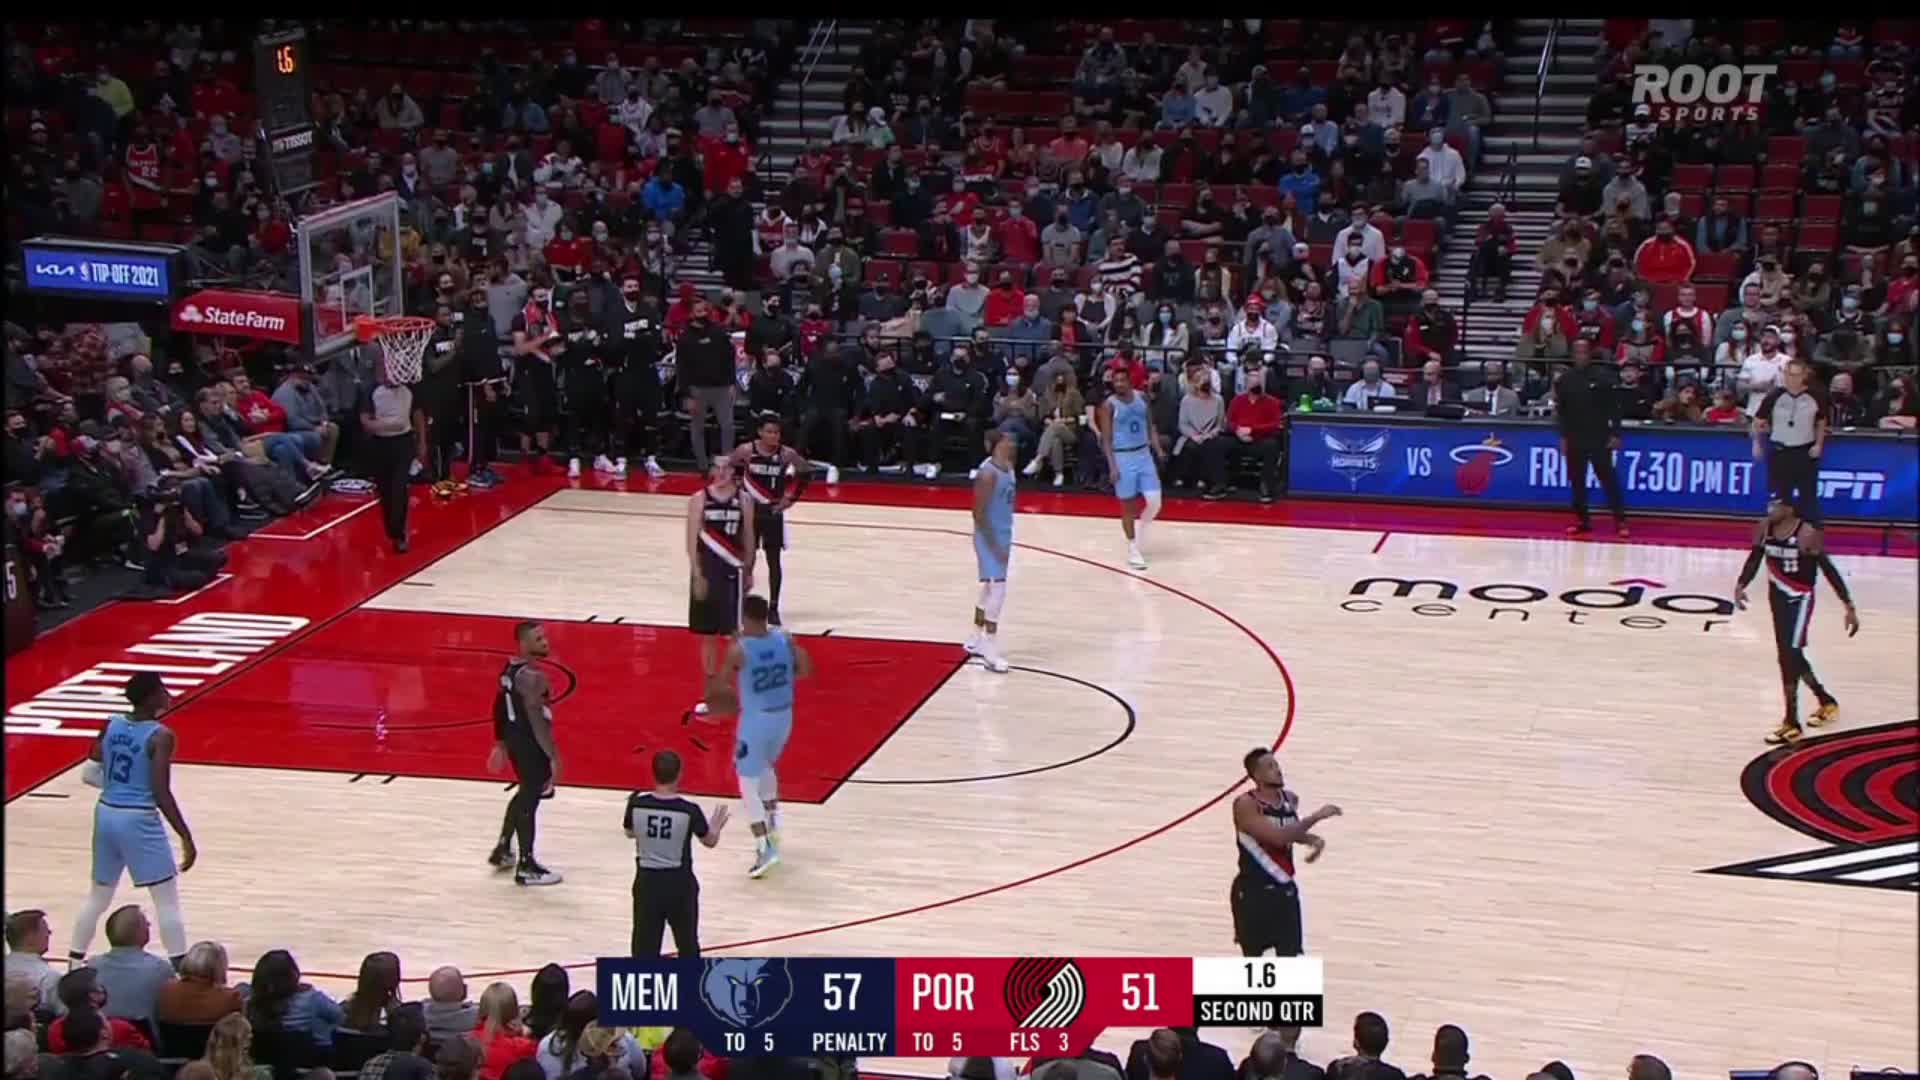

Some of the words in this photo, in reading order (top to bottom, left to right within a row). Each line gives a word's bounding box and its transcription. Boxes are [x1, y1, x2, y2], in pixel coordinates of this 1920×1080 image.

[131, 265, 159, 287] 2021
[1130, 420, 1141, 434] 0
[1407, 447, 1433, 477] VS
[1624, 450, 1684, 493] 7:30
[1690, 459, 1723, 494] PM
[1729, 461, 1753, 495] ET
[1349, 577, 1736, 616] moda
[1340, 599, 1731, 632] center
[752, 663, 788, 694] 22
[108, 751, 133, 784] 13
[647, 814, 673, 839] 52
